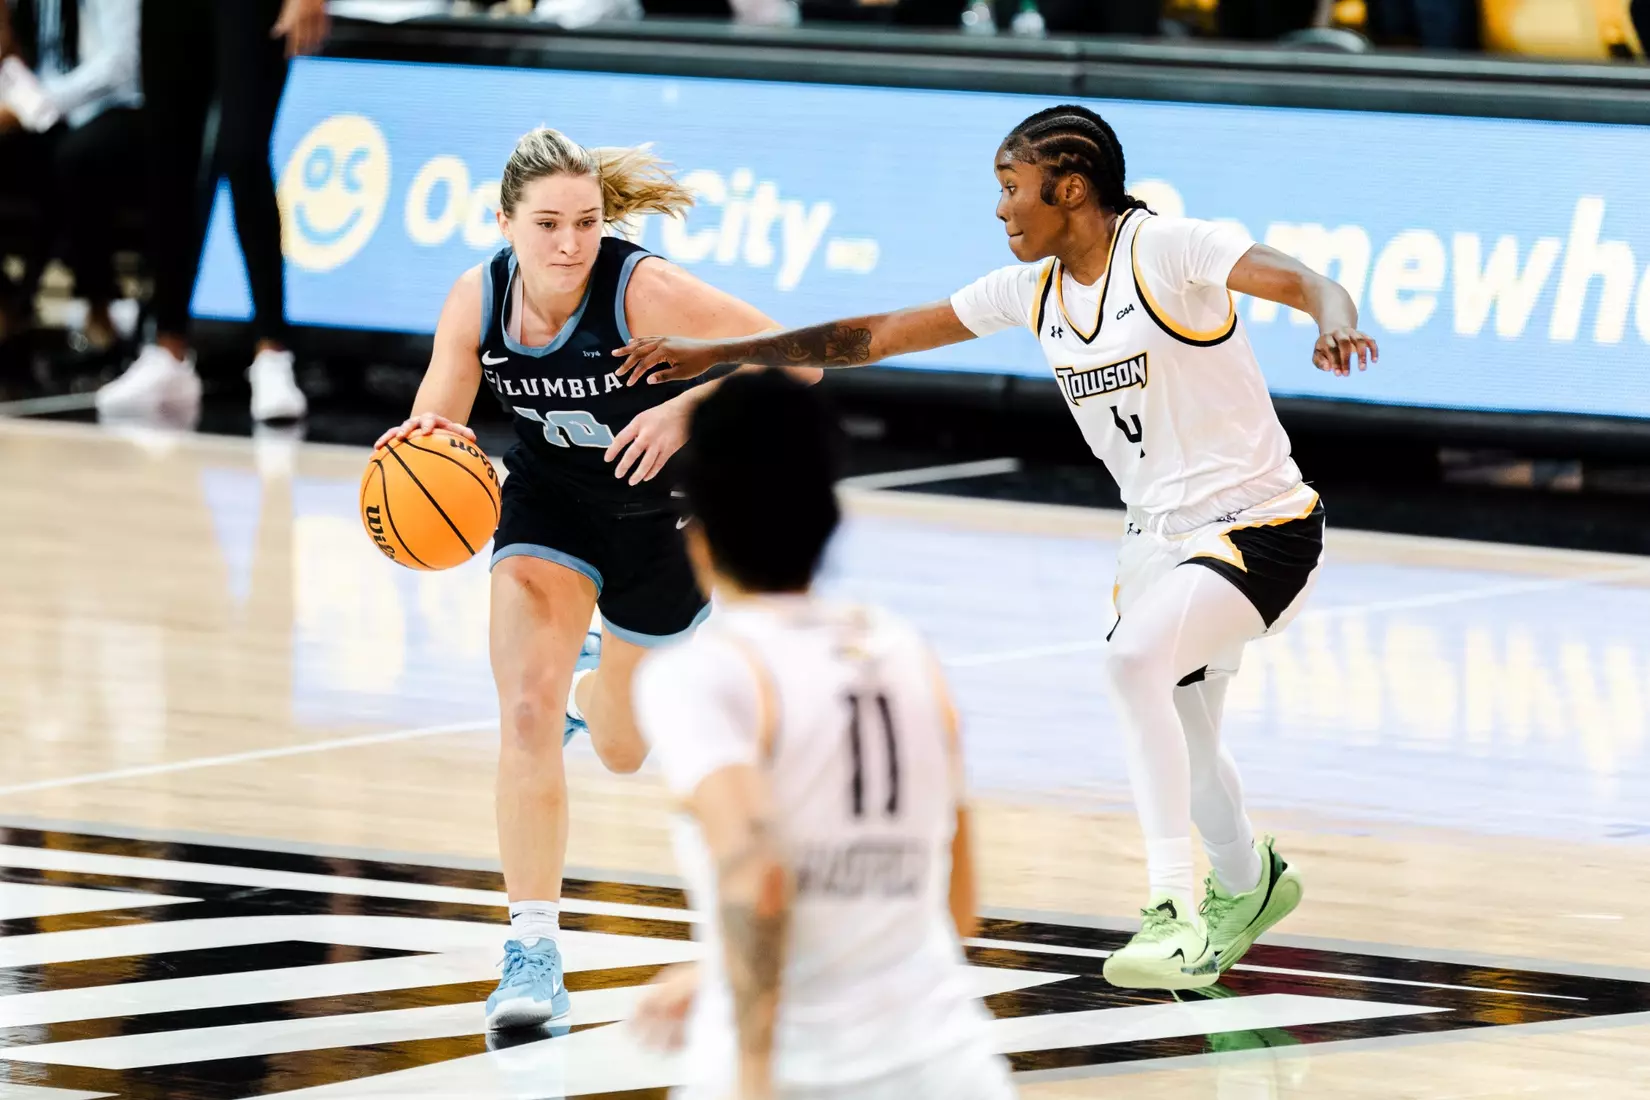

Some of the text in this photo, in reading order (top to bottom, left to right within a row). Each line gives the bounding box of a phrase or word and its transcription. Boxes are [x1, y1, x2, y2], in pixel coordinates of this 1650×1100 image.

[662, 168, 834, 291] City
[1116, 303, 1135, 320] CAA
[1109, 405, 1145, 459] 4
[845, 689, 900, 817] 11
